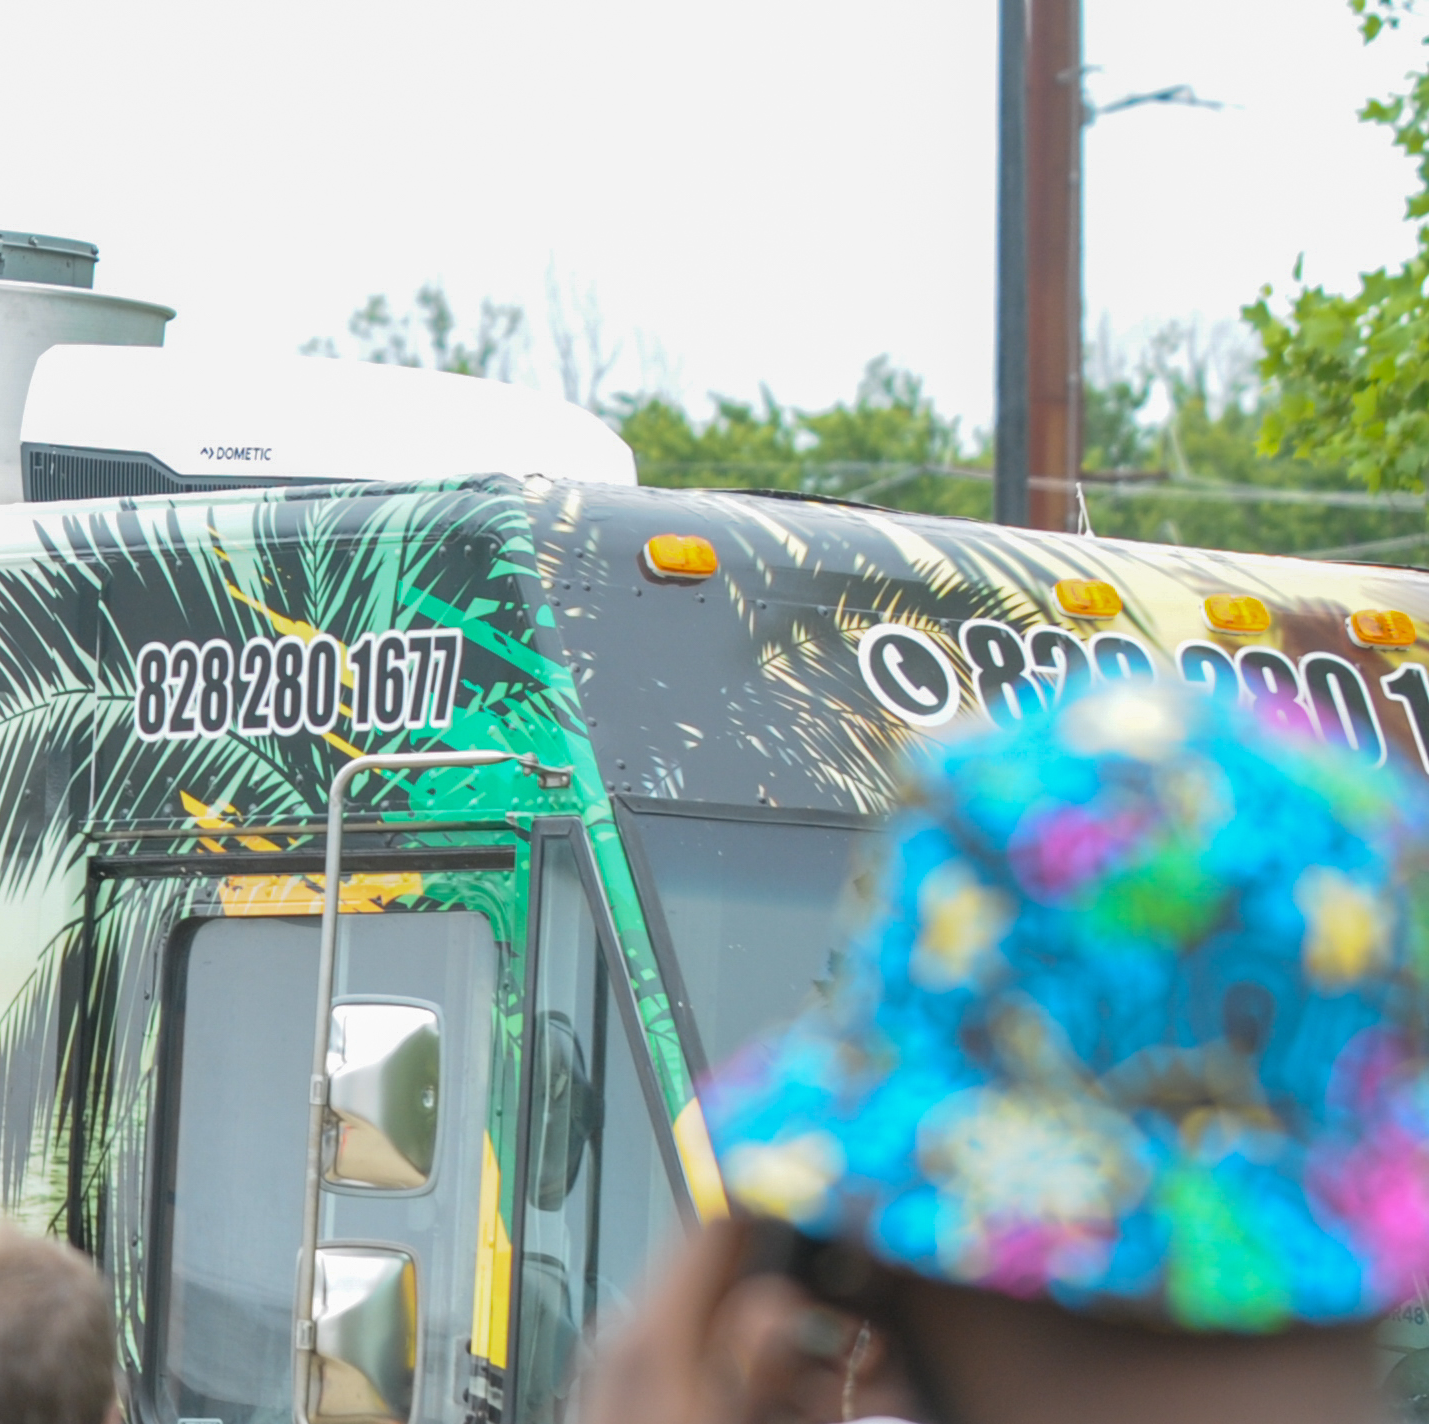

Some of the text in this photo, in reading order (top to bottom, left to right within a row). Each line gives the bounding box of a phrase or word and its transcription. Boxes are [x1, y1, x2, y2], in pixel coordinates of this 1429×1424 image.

[216, 447, 272, 461] DOMETIC
[135, 628, 463, 742] 828 280 1677
